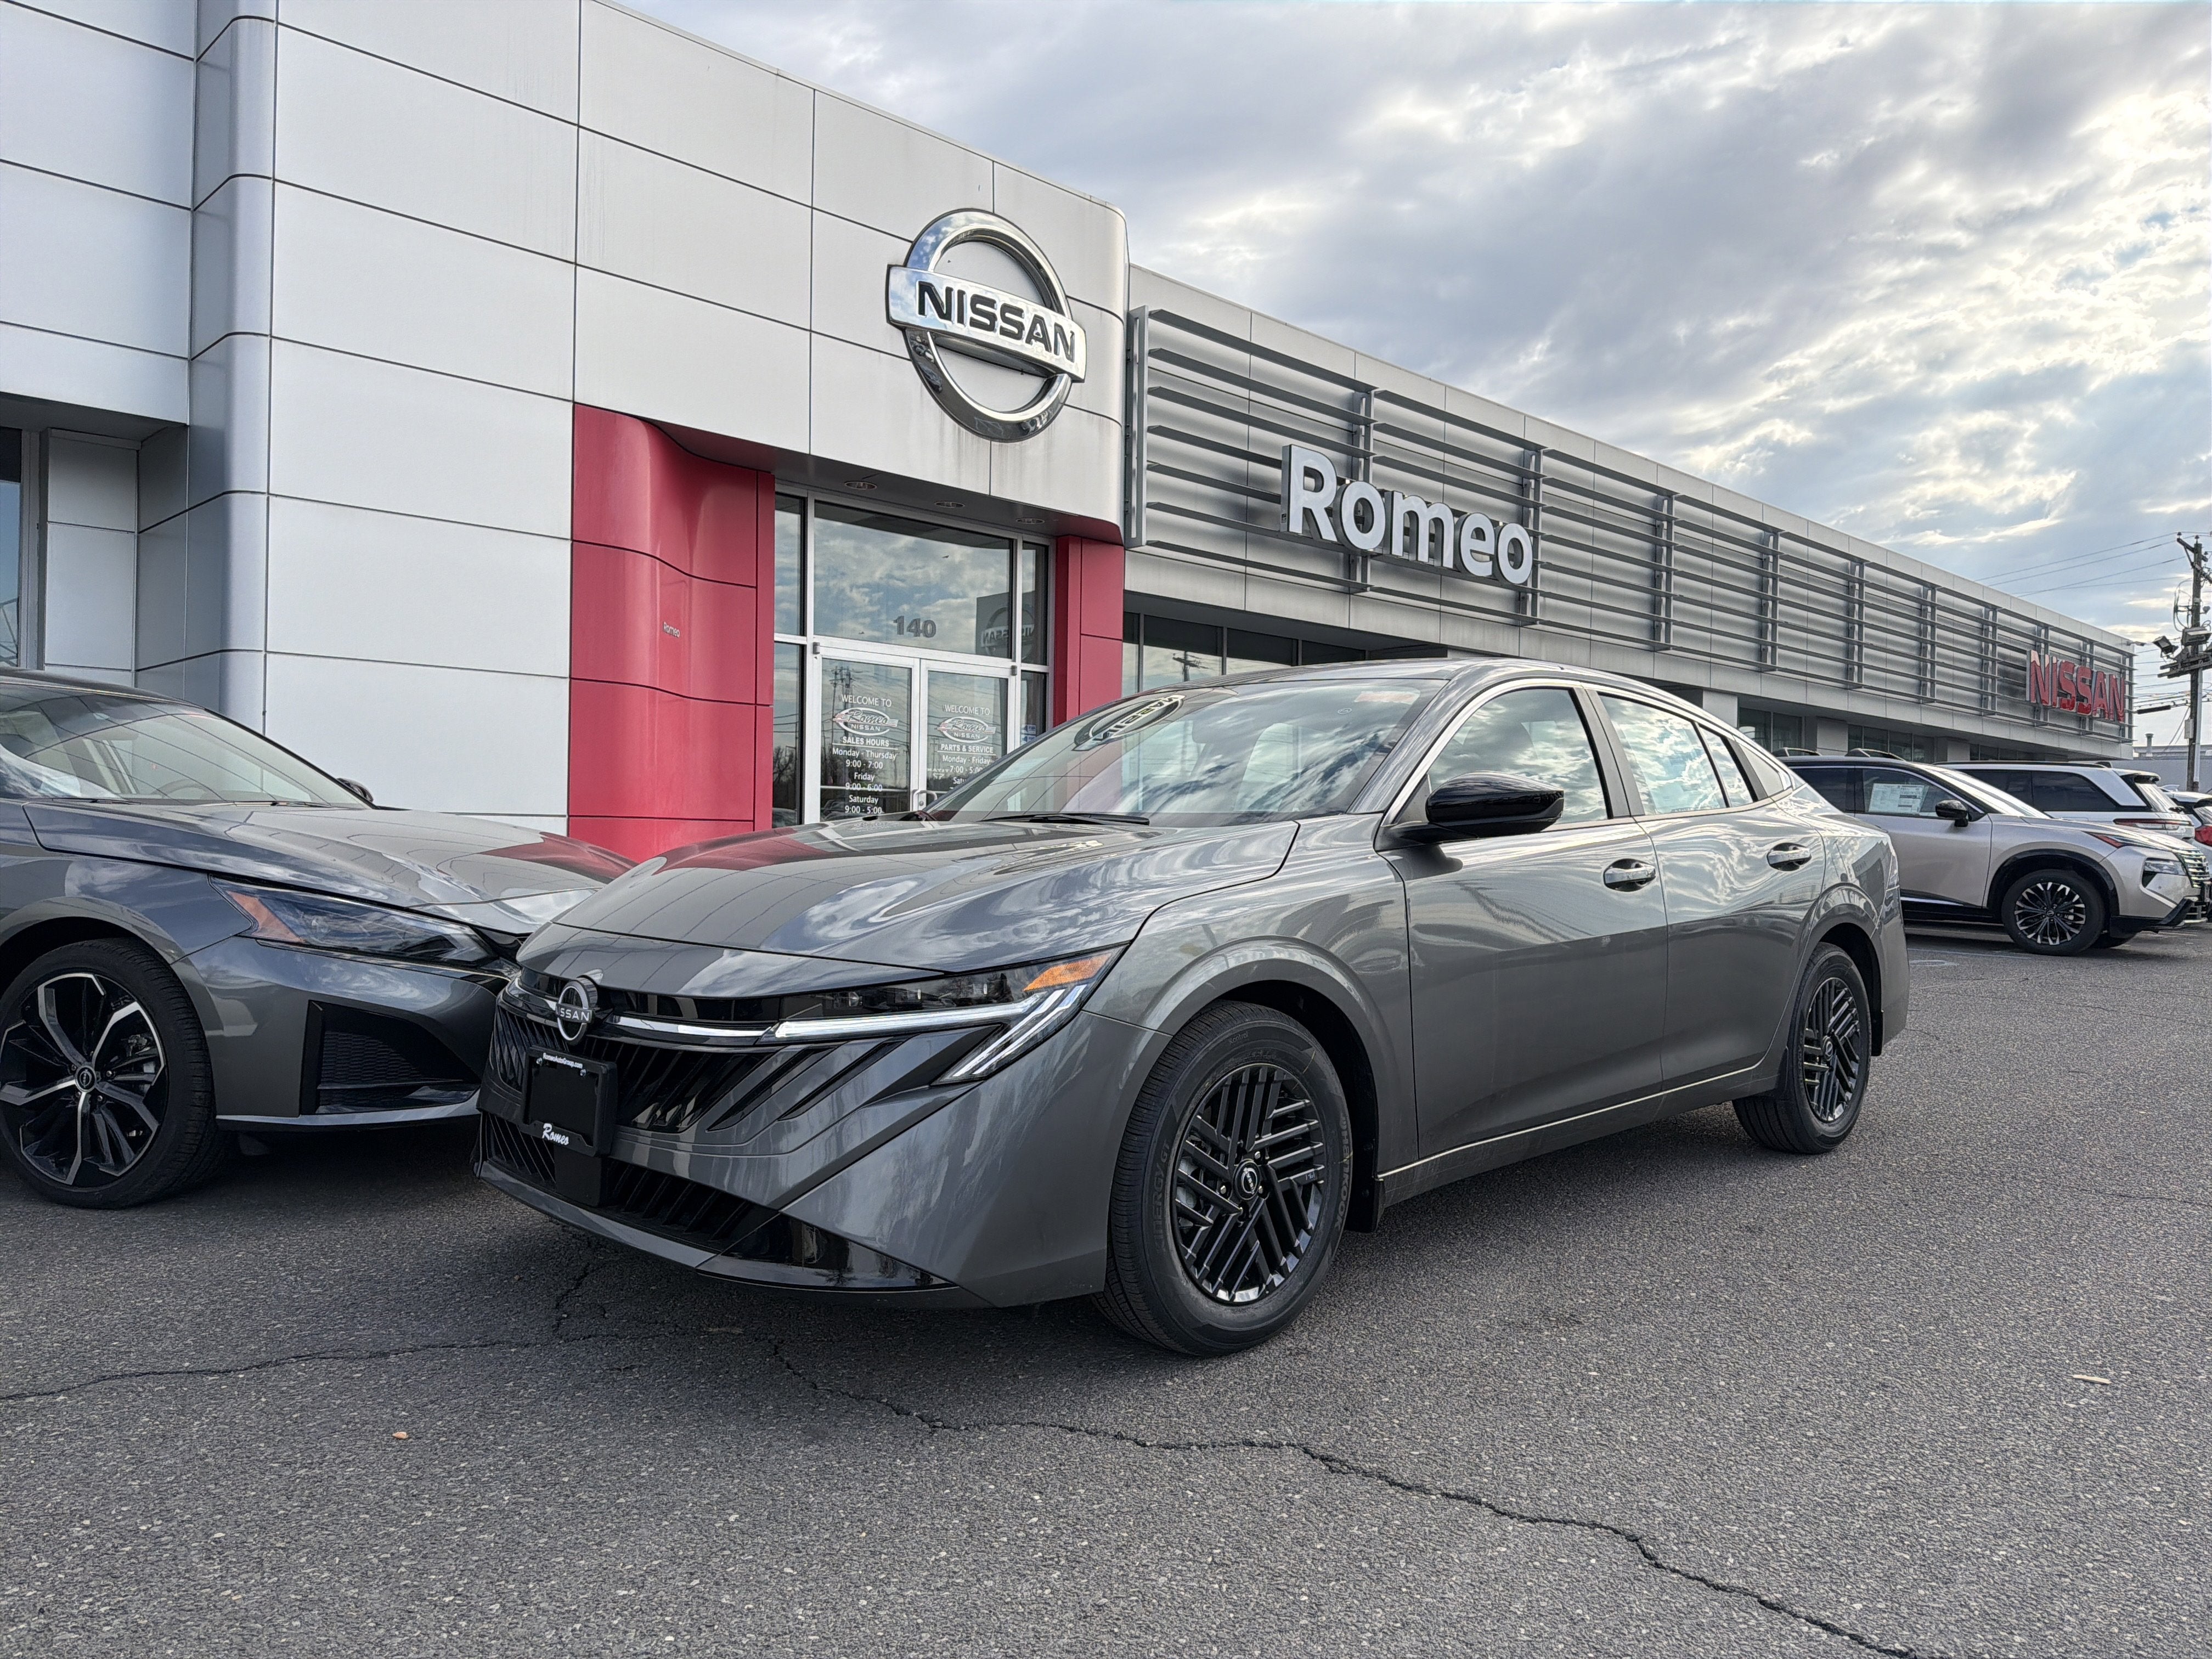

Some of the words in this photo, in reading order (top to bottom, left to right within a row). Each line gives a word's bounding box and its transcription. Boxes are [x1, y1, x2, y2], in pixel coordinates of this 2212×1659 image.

[918, 280, 1075, 363] NISSAN
[1282, 444, 1533, 584] Romeo
[663, 621, 680, 638] Romeo
[893, 616, 936, 638] 140
[2027, 650, 2125, 724] NISSAN
[841, 694, 879, 706] WELCOME
[881, 698, 891, 707] TO
[945, 704, 978, 714] WELCOME
[980, 707, 990, 715] TO
[845, 709, 888, 724] Romeo
[843, 736, 864, 745] SALES
[866, 738, 889, 747] HOURS
[832, 747, 860, 758] Monday
[866, 749, 897, 760] Thursday
[943, 755, 966, 764] Monday
[972, 757, 990, 765] Friday
[845, 759, 861, 768] 9:00
[868, 760, 883, 769] 7:00
[854, 772, 875, 782] Friday
[845, 782, 861, 791] 9:00
[867, 783, 883, 792] 6:00
[849, 794, 879, 805] Saturday
[845, 805, 860, 814] 9:00
[867, 806, 882, 814] 5:00
[1228, 1031, 1249, 1045] Kontrol
[542, 1123, 569, 1146] Romeo
